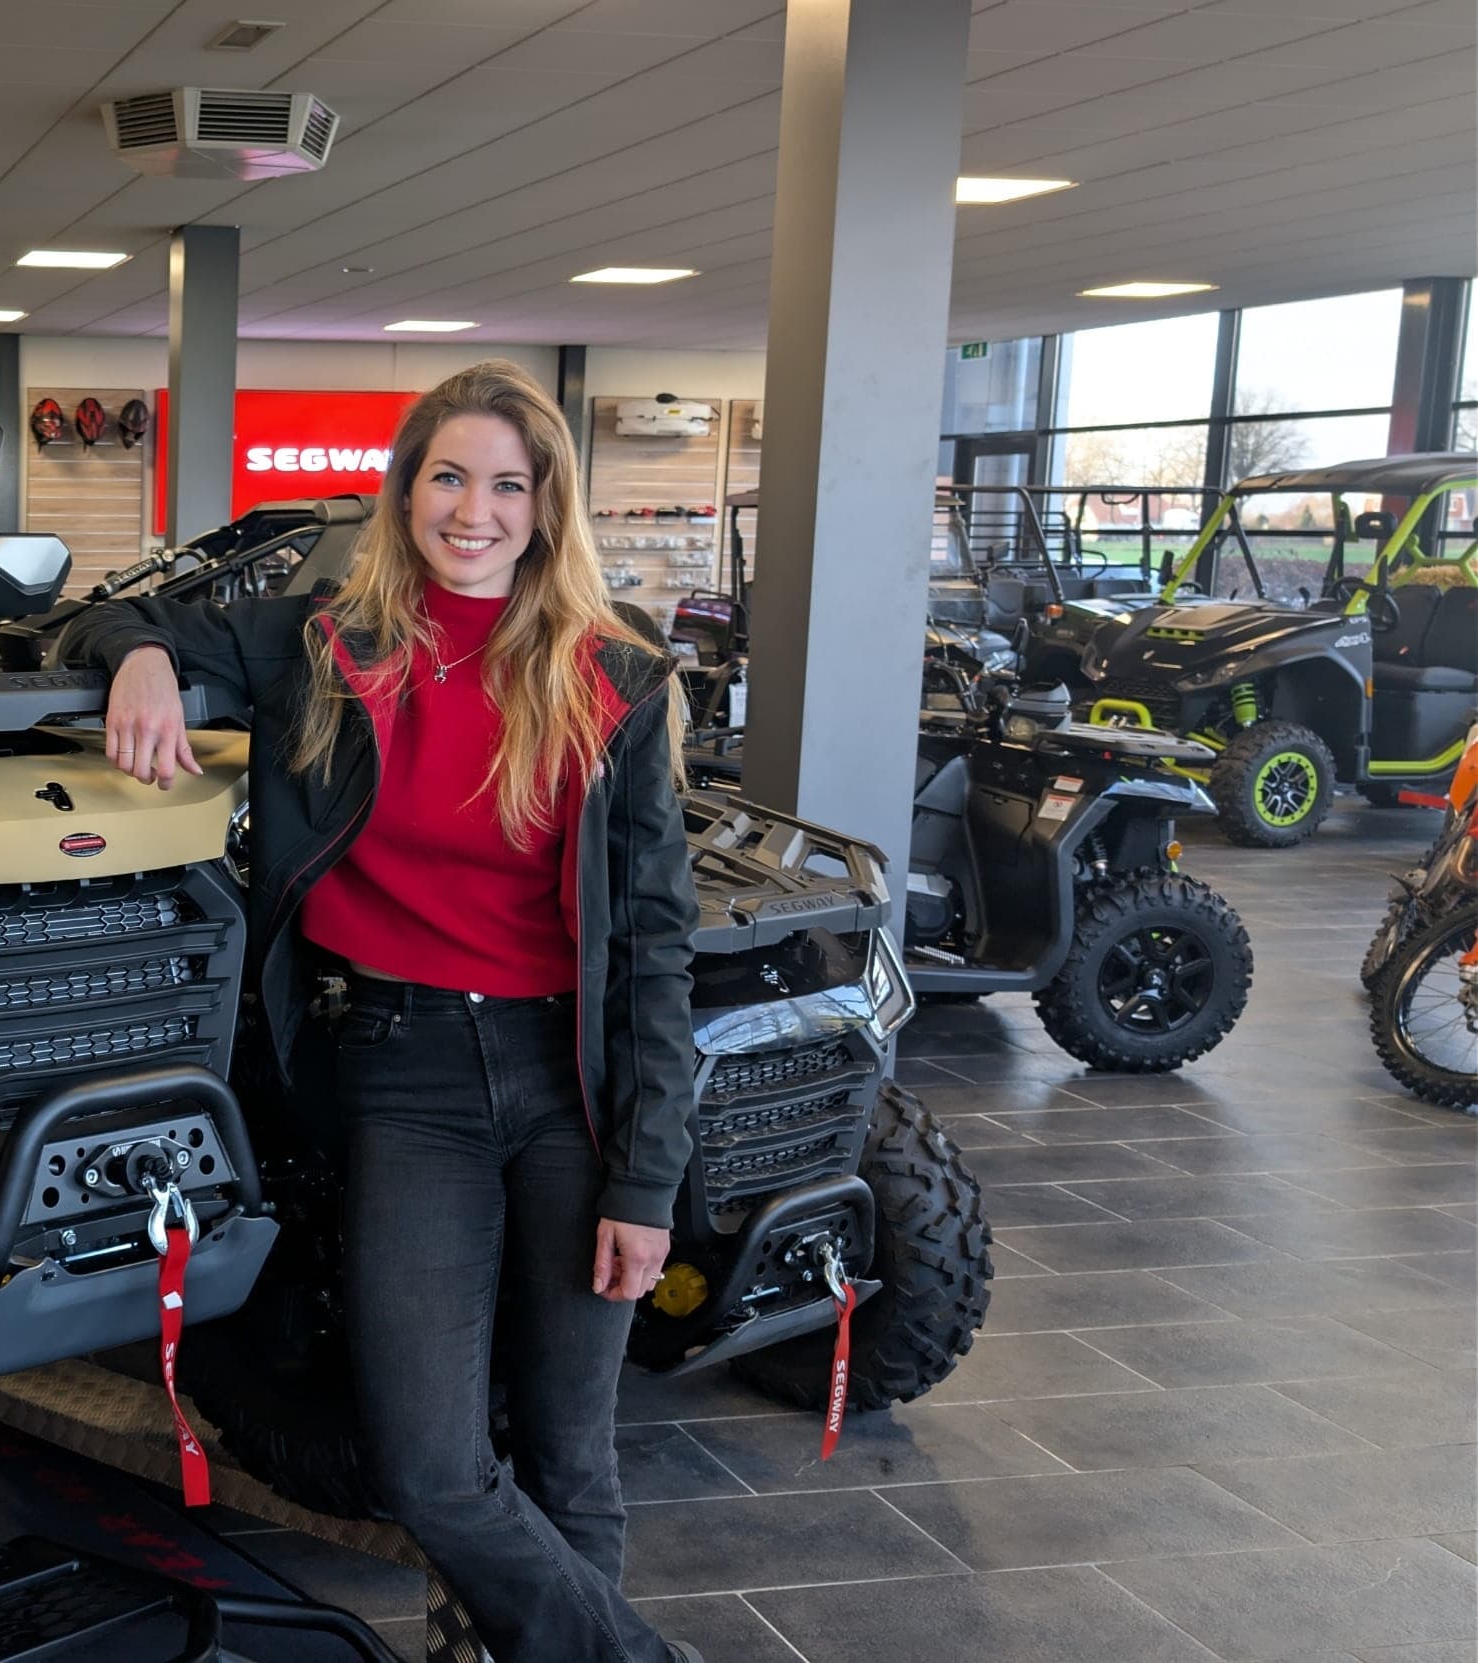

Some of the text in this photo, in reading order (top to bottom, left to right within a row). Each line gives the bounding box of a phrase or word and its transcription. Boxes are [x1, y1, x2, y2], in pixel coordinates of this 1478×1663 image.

[9, 673, 106, 688] SEGWA
[770, 895, 836, 916] SEGWAY
[829, 1359, 846, 1433] SEGWAY
